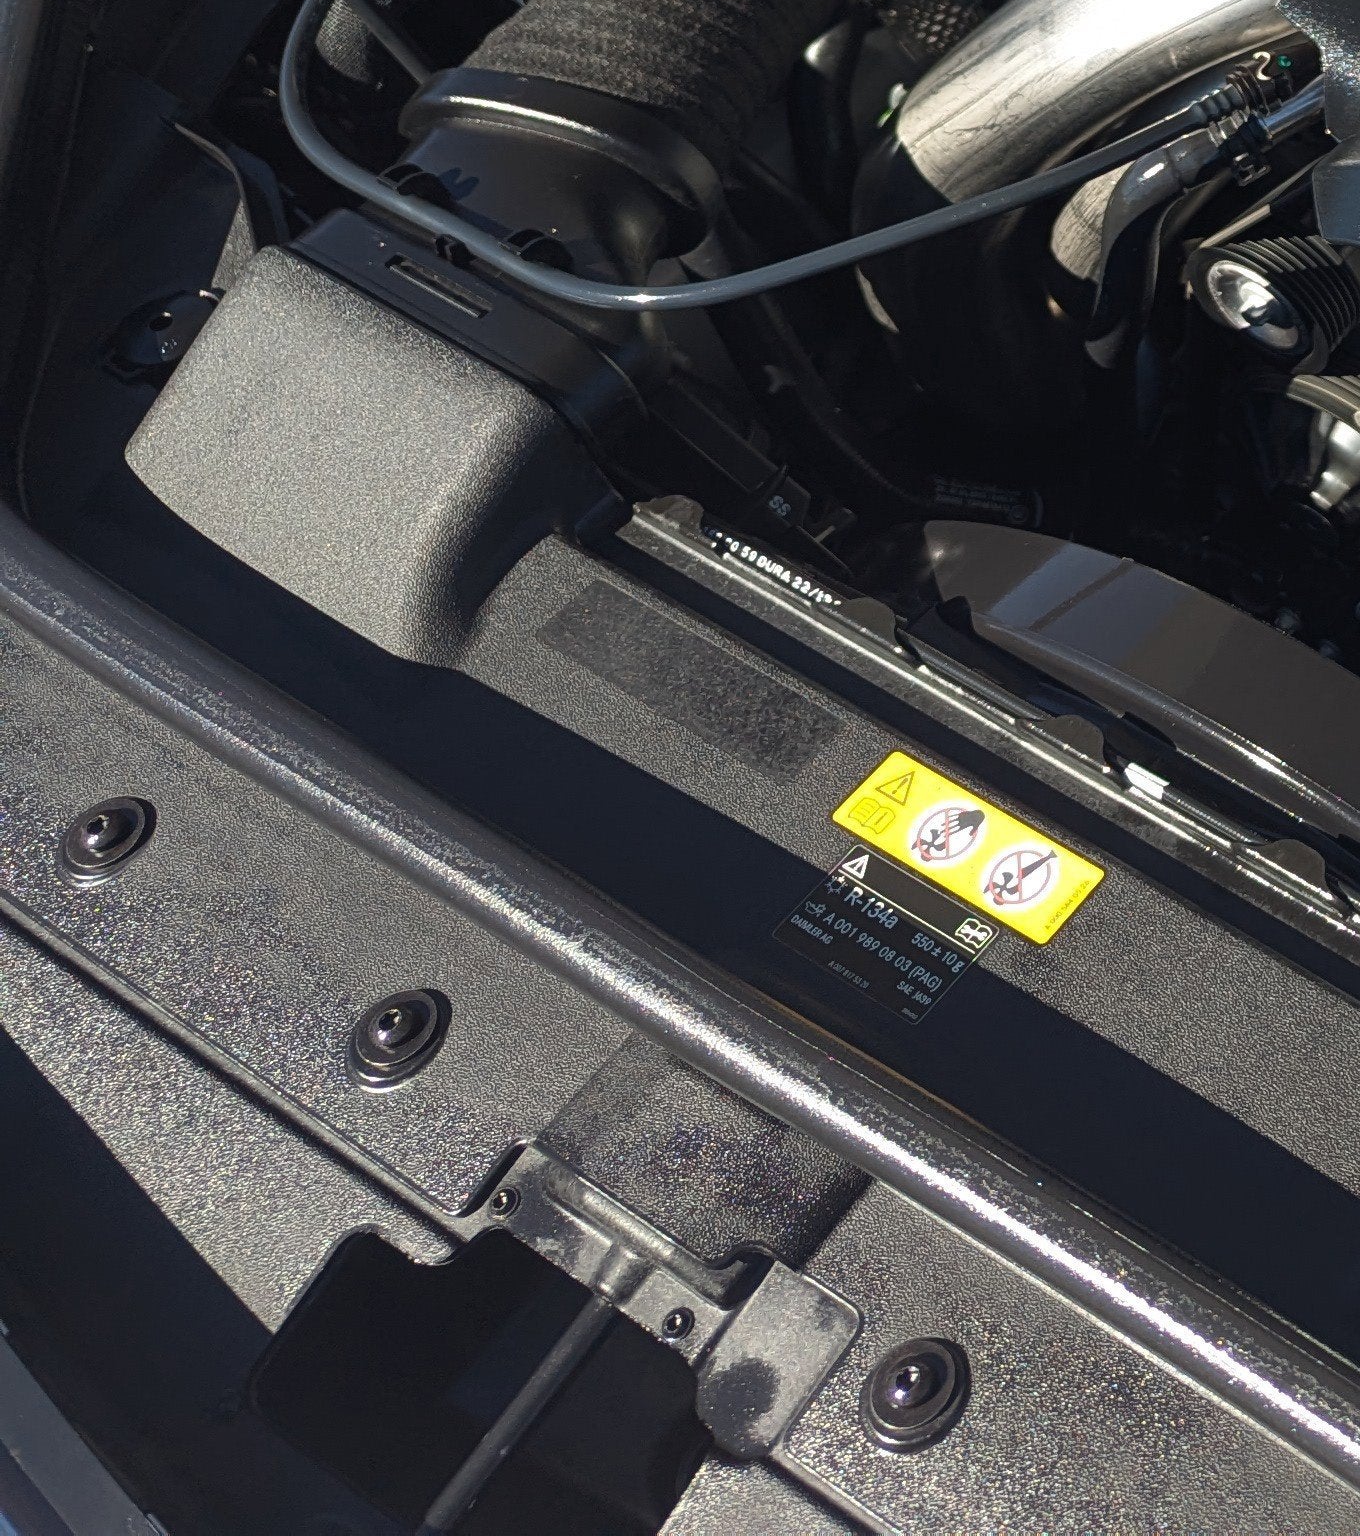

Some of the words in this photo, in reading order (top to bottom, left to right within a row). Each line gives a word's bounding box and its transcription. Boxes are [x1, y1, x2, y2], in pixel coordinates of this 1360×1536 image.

[756, 555, 791, 583] DURA
[844, 886, 898, 930] R-134a
[790, 914, 822, 939] DAIMLER
[823, 912, 836, 926] A
[834, 918, 859, 938] 001
[856, 932, 881, 951] 989
[878, 946, 896, 962] 08
[894, 956, 912, 973] 03
[907, 965, 943, 993] (PAG)
[896, 980, 914, 995] SAE
